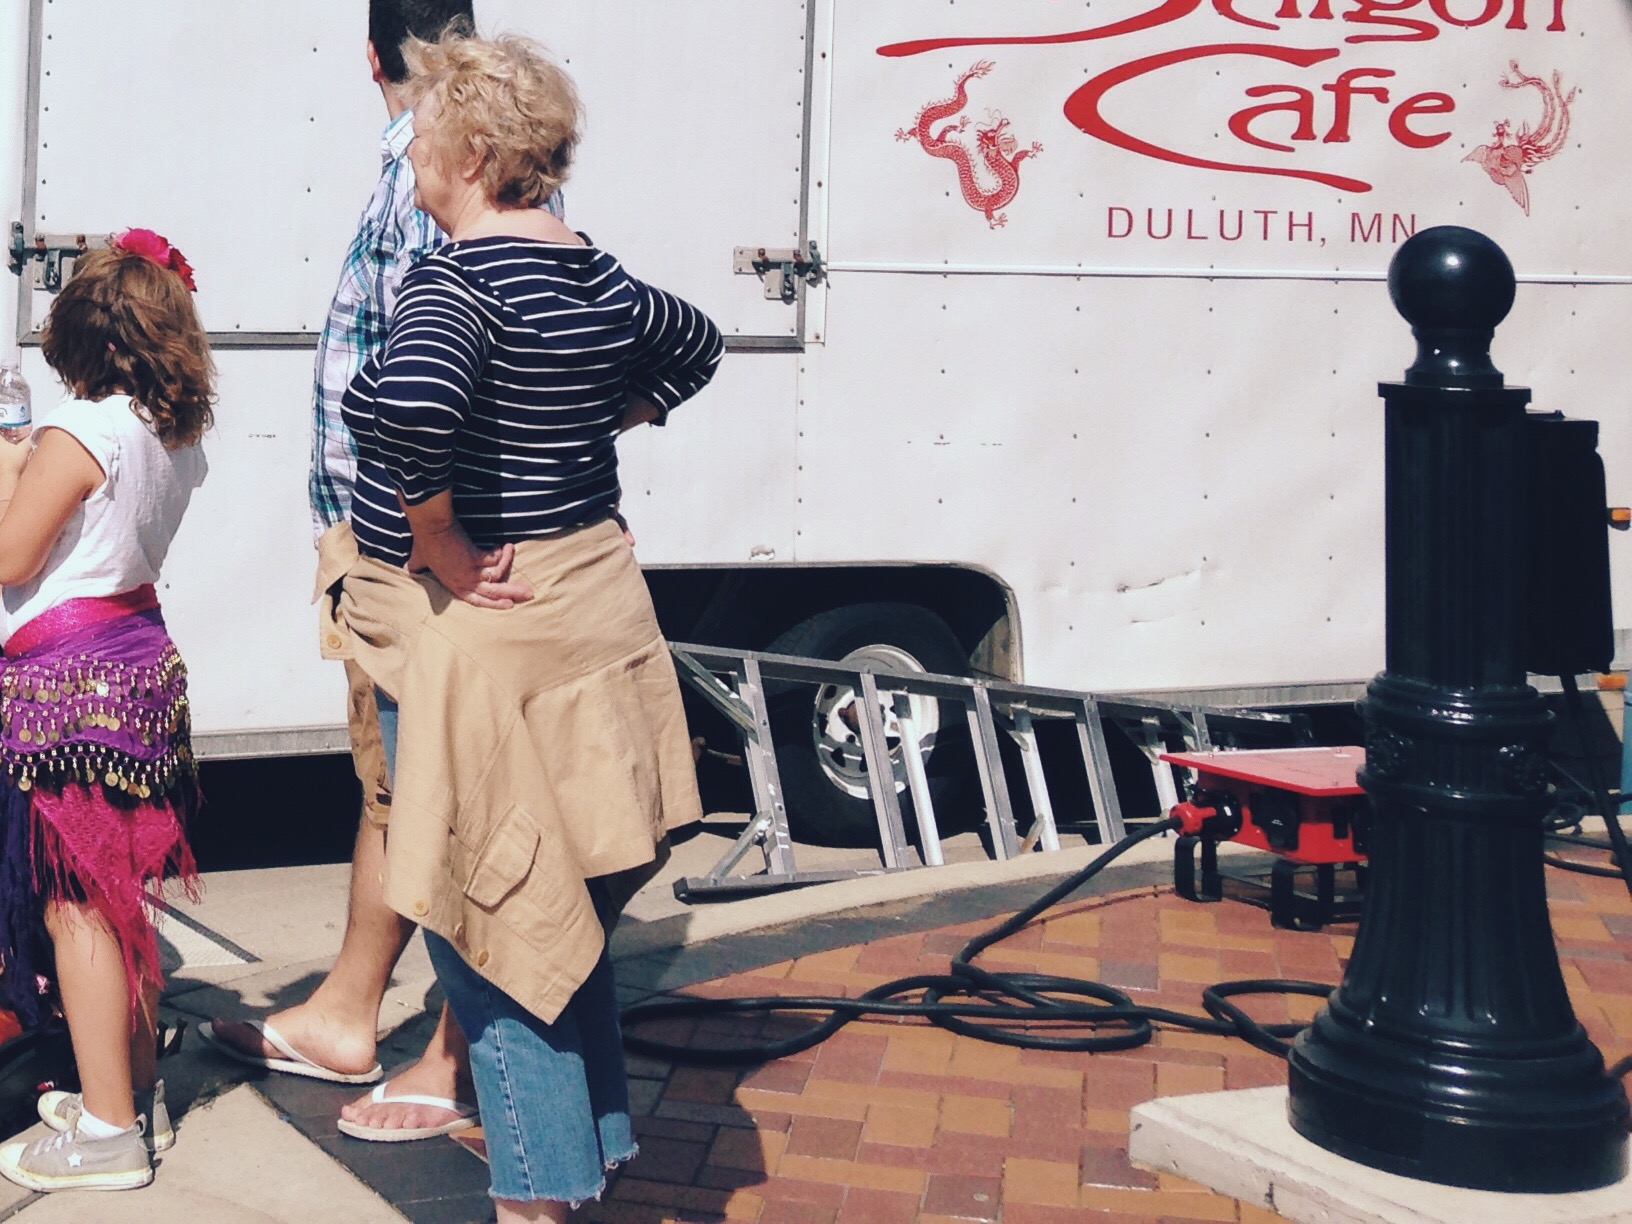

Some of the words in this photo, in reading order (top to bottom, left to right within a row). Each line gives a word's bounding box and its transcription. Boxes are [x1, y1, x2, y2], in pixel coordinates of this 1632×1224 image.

[1063, 44, 1456, 194] Cafe
[1107, 206, 1326, 247] DULUTH,
[1350, 211, 1416, 244] MN
